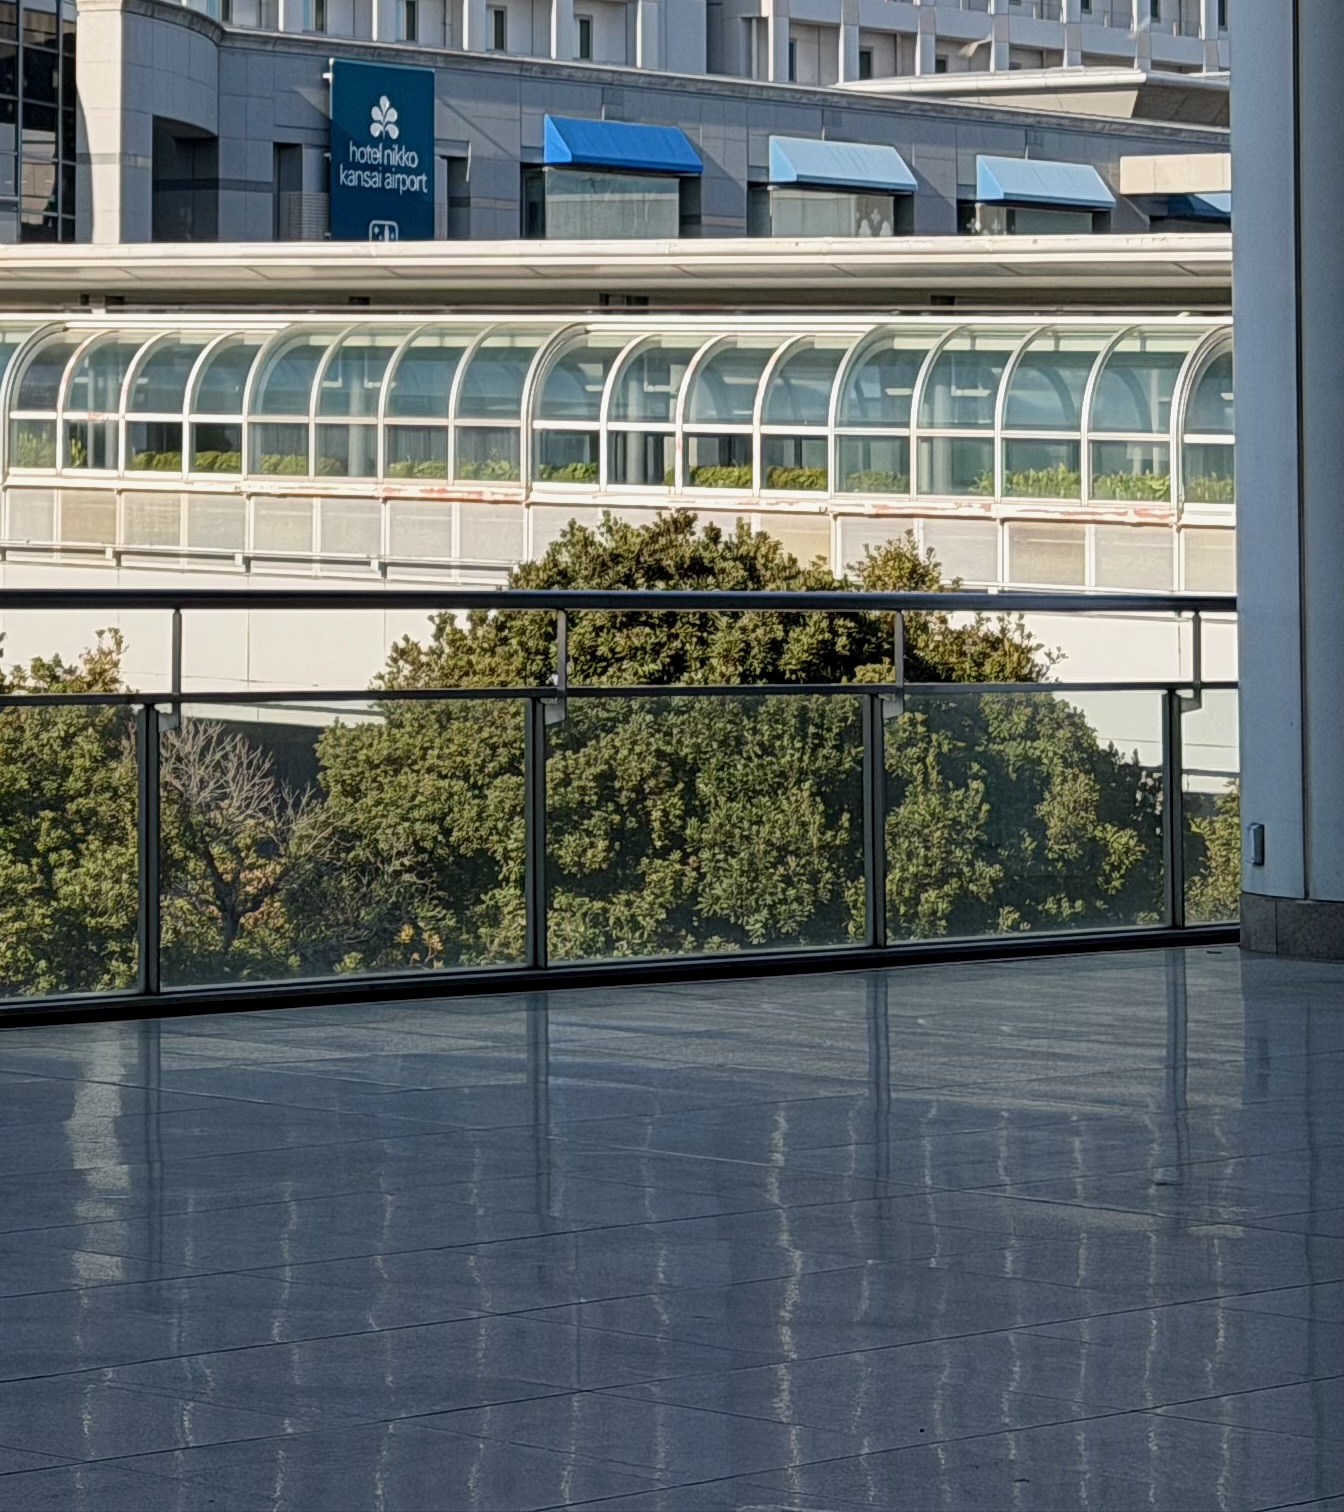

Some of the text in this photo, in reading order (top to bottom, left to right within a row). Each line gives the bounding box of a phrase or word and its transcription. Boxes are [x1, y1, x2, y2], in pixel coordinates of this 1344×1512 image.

[349, 140, 419, 168] hotel nikko
[339, 164, 428, 195] kansai airport
